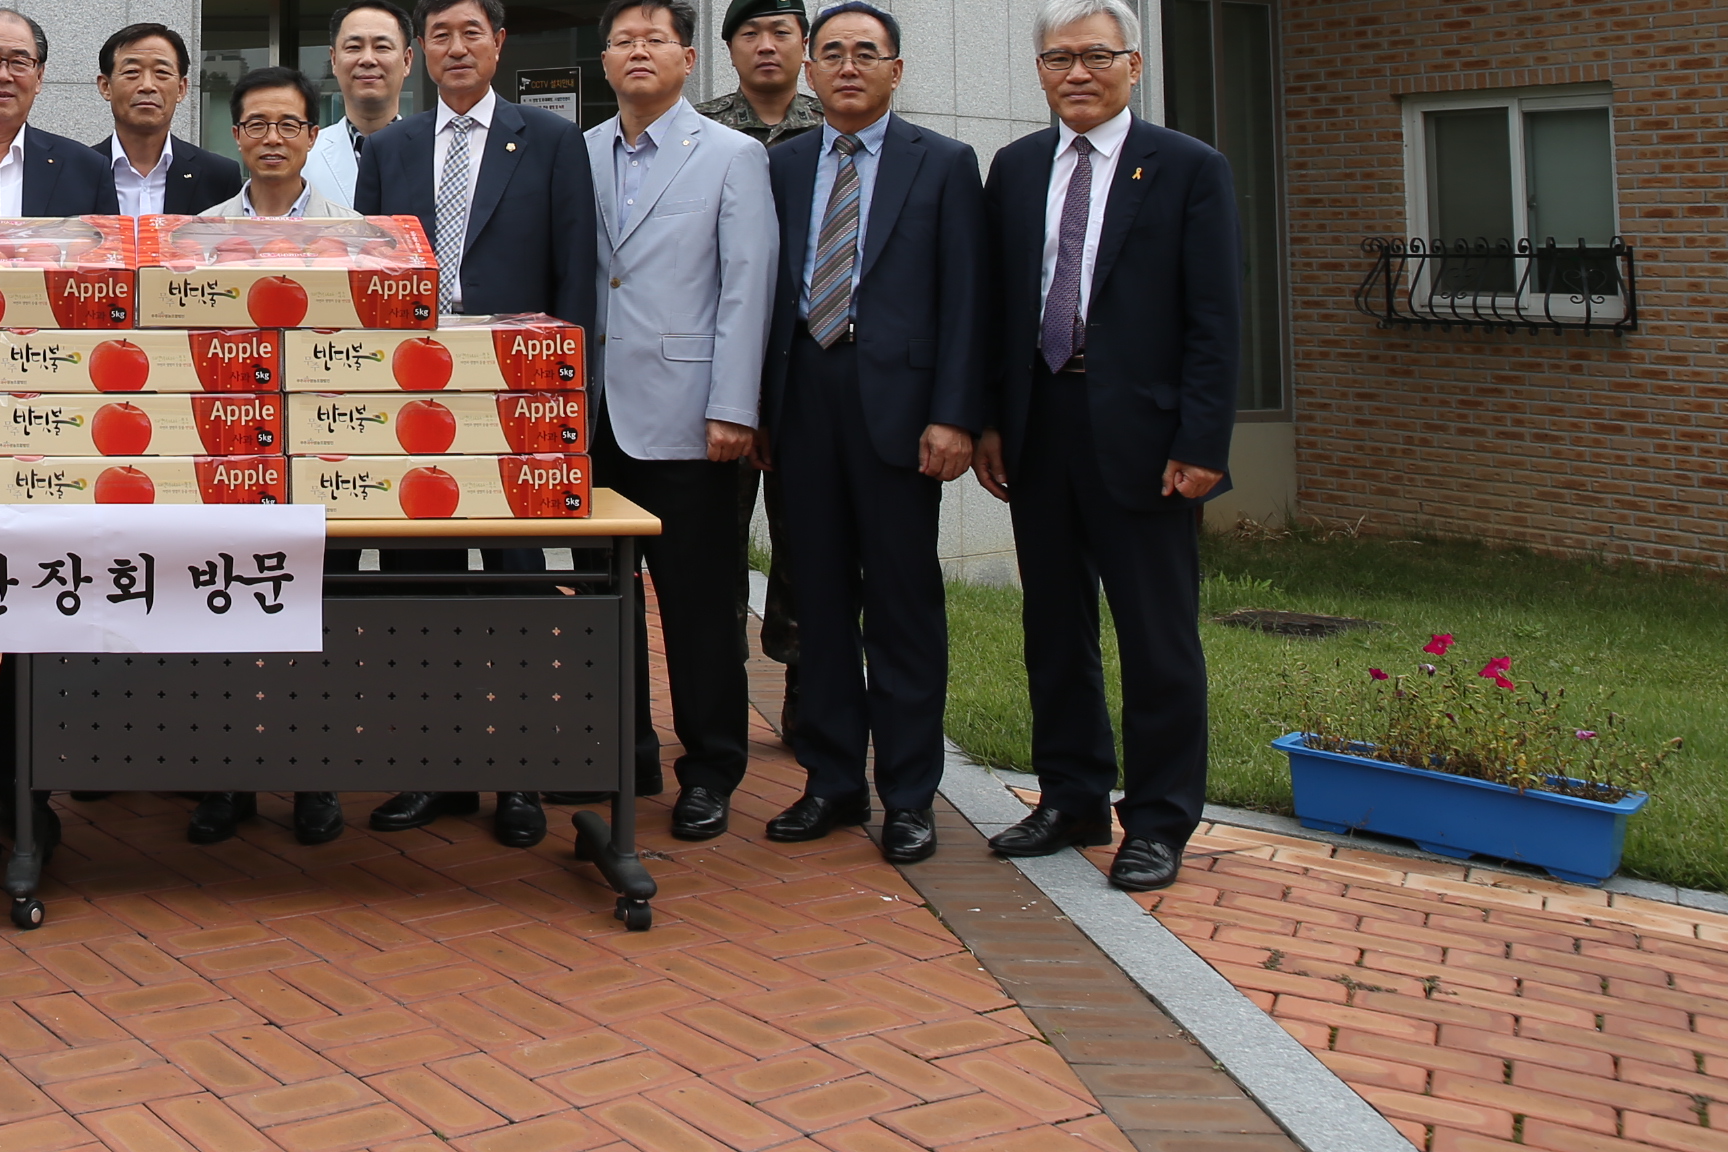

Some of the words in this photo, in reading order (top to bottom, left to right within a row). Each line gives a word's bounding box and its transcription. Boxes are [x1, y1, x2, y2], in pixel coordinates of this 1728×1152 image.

[530, 79, 549, 89] CCTV
[63, 277, 128, 302] Apple
[168, 278, 234, 308] 반딧불
[367, 274, 432, 300] Apple
[85, 310, 106, 321] 사과
[111, 310, 126, 320] 5kg
[389, 309, 409, 318] 사과
[414, 308, 429, 317] 5kg
[10, 342, 75, 373] 반딧불
[207, 337, 272, 363] Apple
[313, 341, 378, 372] 반딧불
[511, 334, 576, 360] Apple
[230, 371, 251, 382] 사과
[255, 371, 270, 381] 5kg
[534, 369, 555, 379] 사과
[559, 367, 574, 378] 5kg
[13, 406, 78, 436] 반딧불
[210, 399, 274, 426] Apple
[317, 403, 382, 434] 반딧불
[514, 397, 579, 423] Apple
[232, 434, 253, 445] 사과
[257, 433, 273, 443] 5kg
[537, 431, 558, 442] 사과
[562, 430, 577, 441] 5kg
[15, 468, 80, 499] 반딧불
[213, 464, 278, 490] Apple
[320, 470, 384, 501] 반딧불
[517, 463, 582, 490] Apple
[540, 498, 561, 509] 사과
[565, 497, 580, 507] 5kg
[187, 550, 295, 616] 방문
